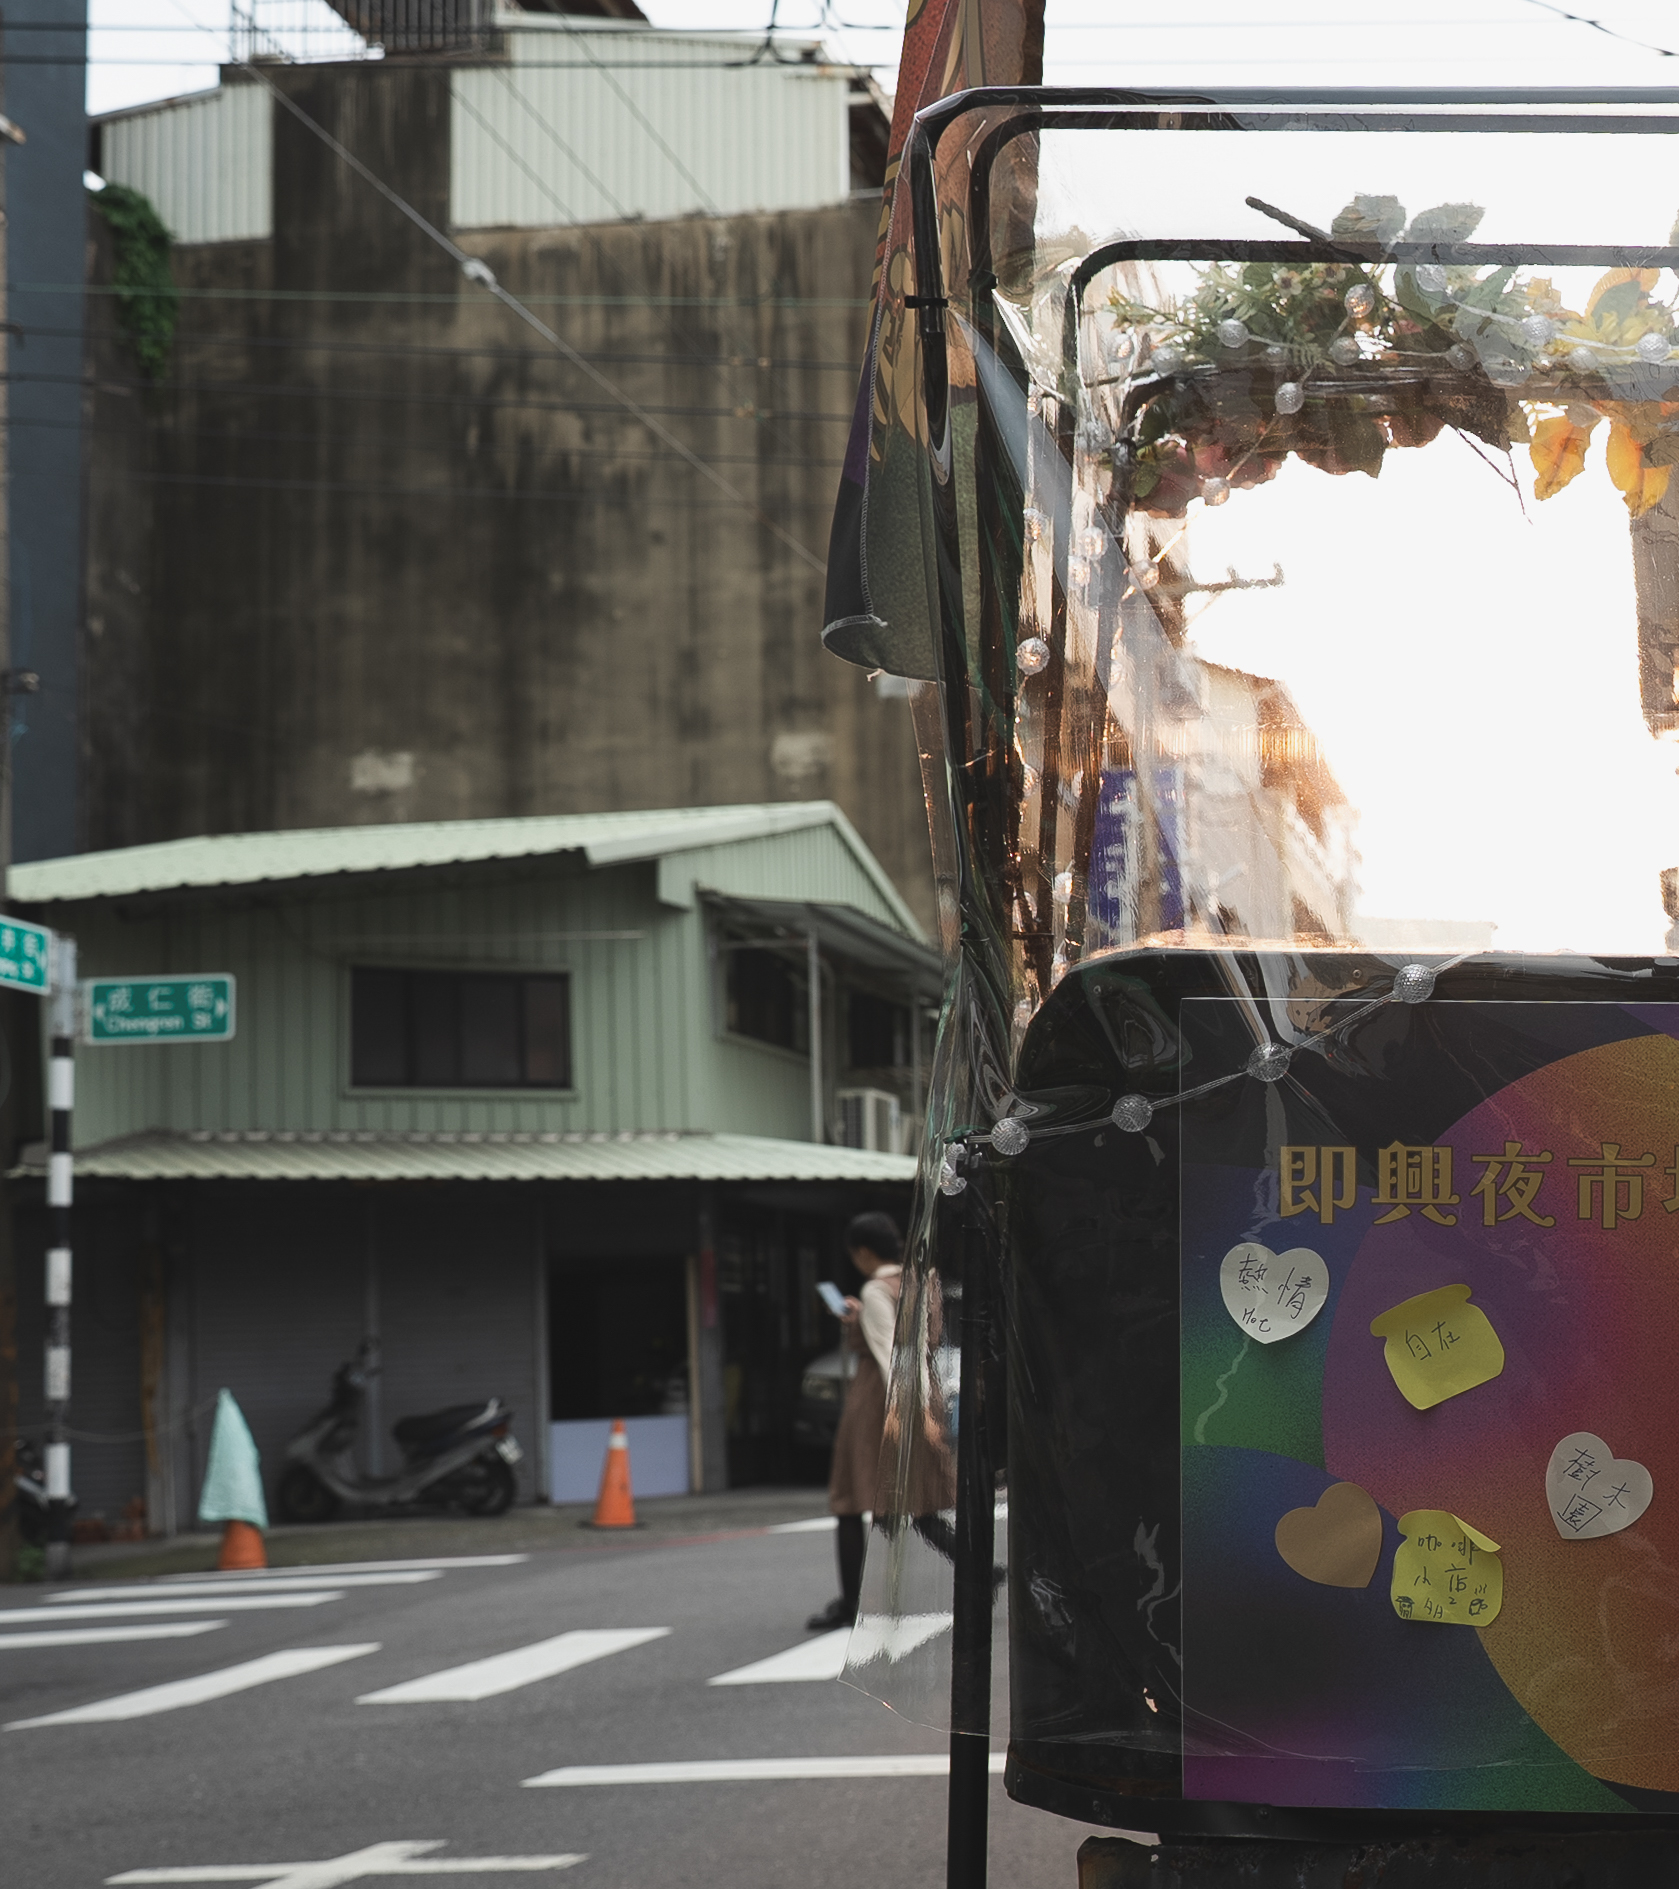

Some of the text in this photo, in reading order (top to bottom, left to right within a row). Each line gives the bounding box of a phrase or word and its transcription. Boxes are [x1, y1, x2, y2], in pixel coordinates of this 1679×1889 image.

[1238, 1252, 1313, 1320] 熱情
[1404, 1320, 1461, 1361] 自在
[1413, 1562, 1469, 1593] 小店
